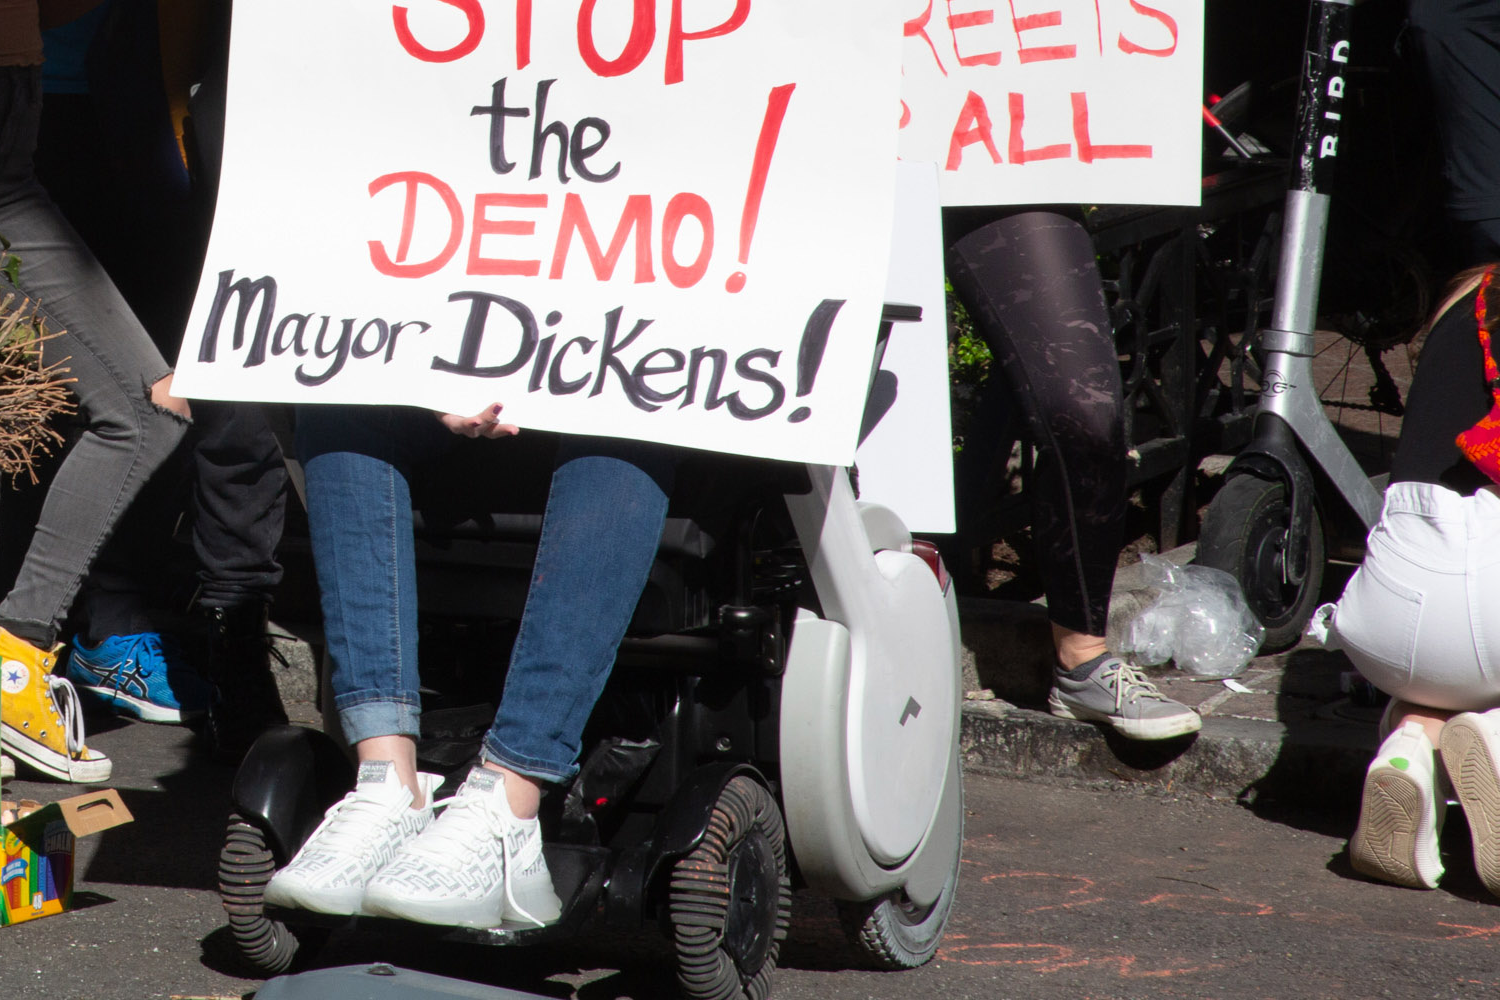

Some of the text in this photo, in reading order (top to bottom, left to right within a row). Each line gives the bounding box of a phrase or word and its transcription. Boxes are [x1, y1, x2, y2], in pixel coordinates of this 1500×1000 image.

[470, 78, 621, 184] the
[945, 90, 1152, 171] ALL
[1320, 40, 1349, 158] BIRD
[367, 83, 796, 295] DEMO!
[198, 269, 430, 387] Mayor
[432, 291, 847, 424] Dickens!
